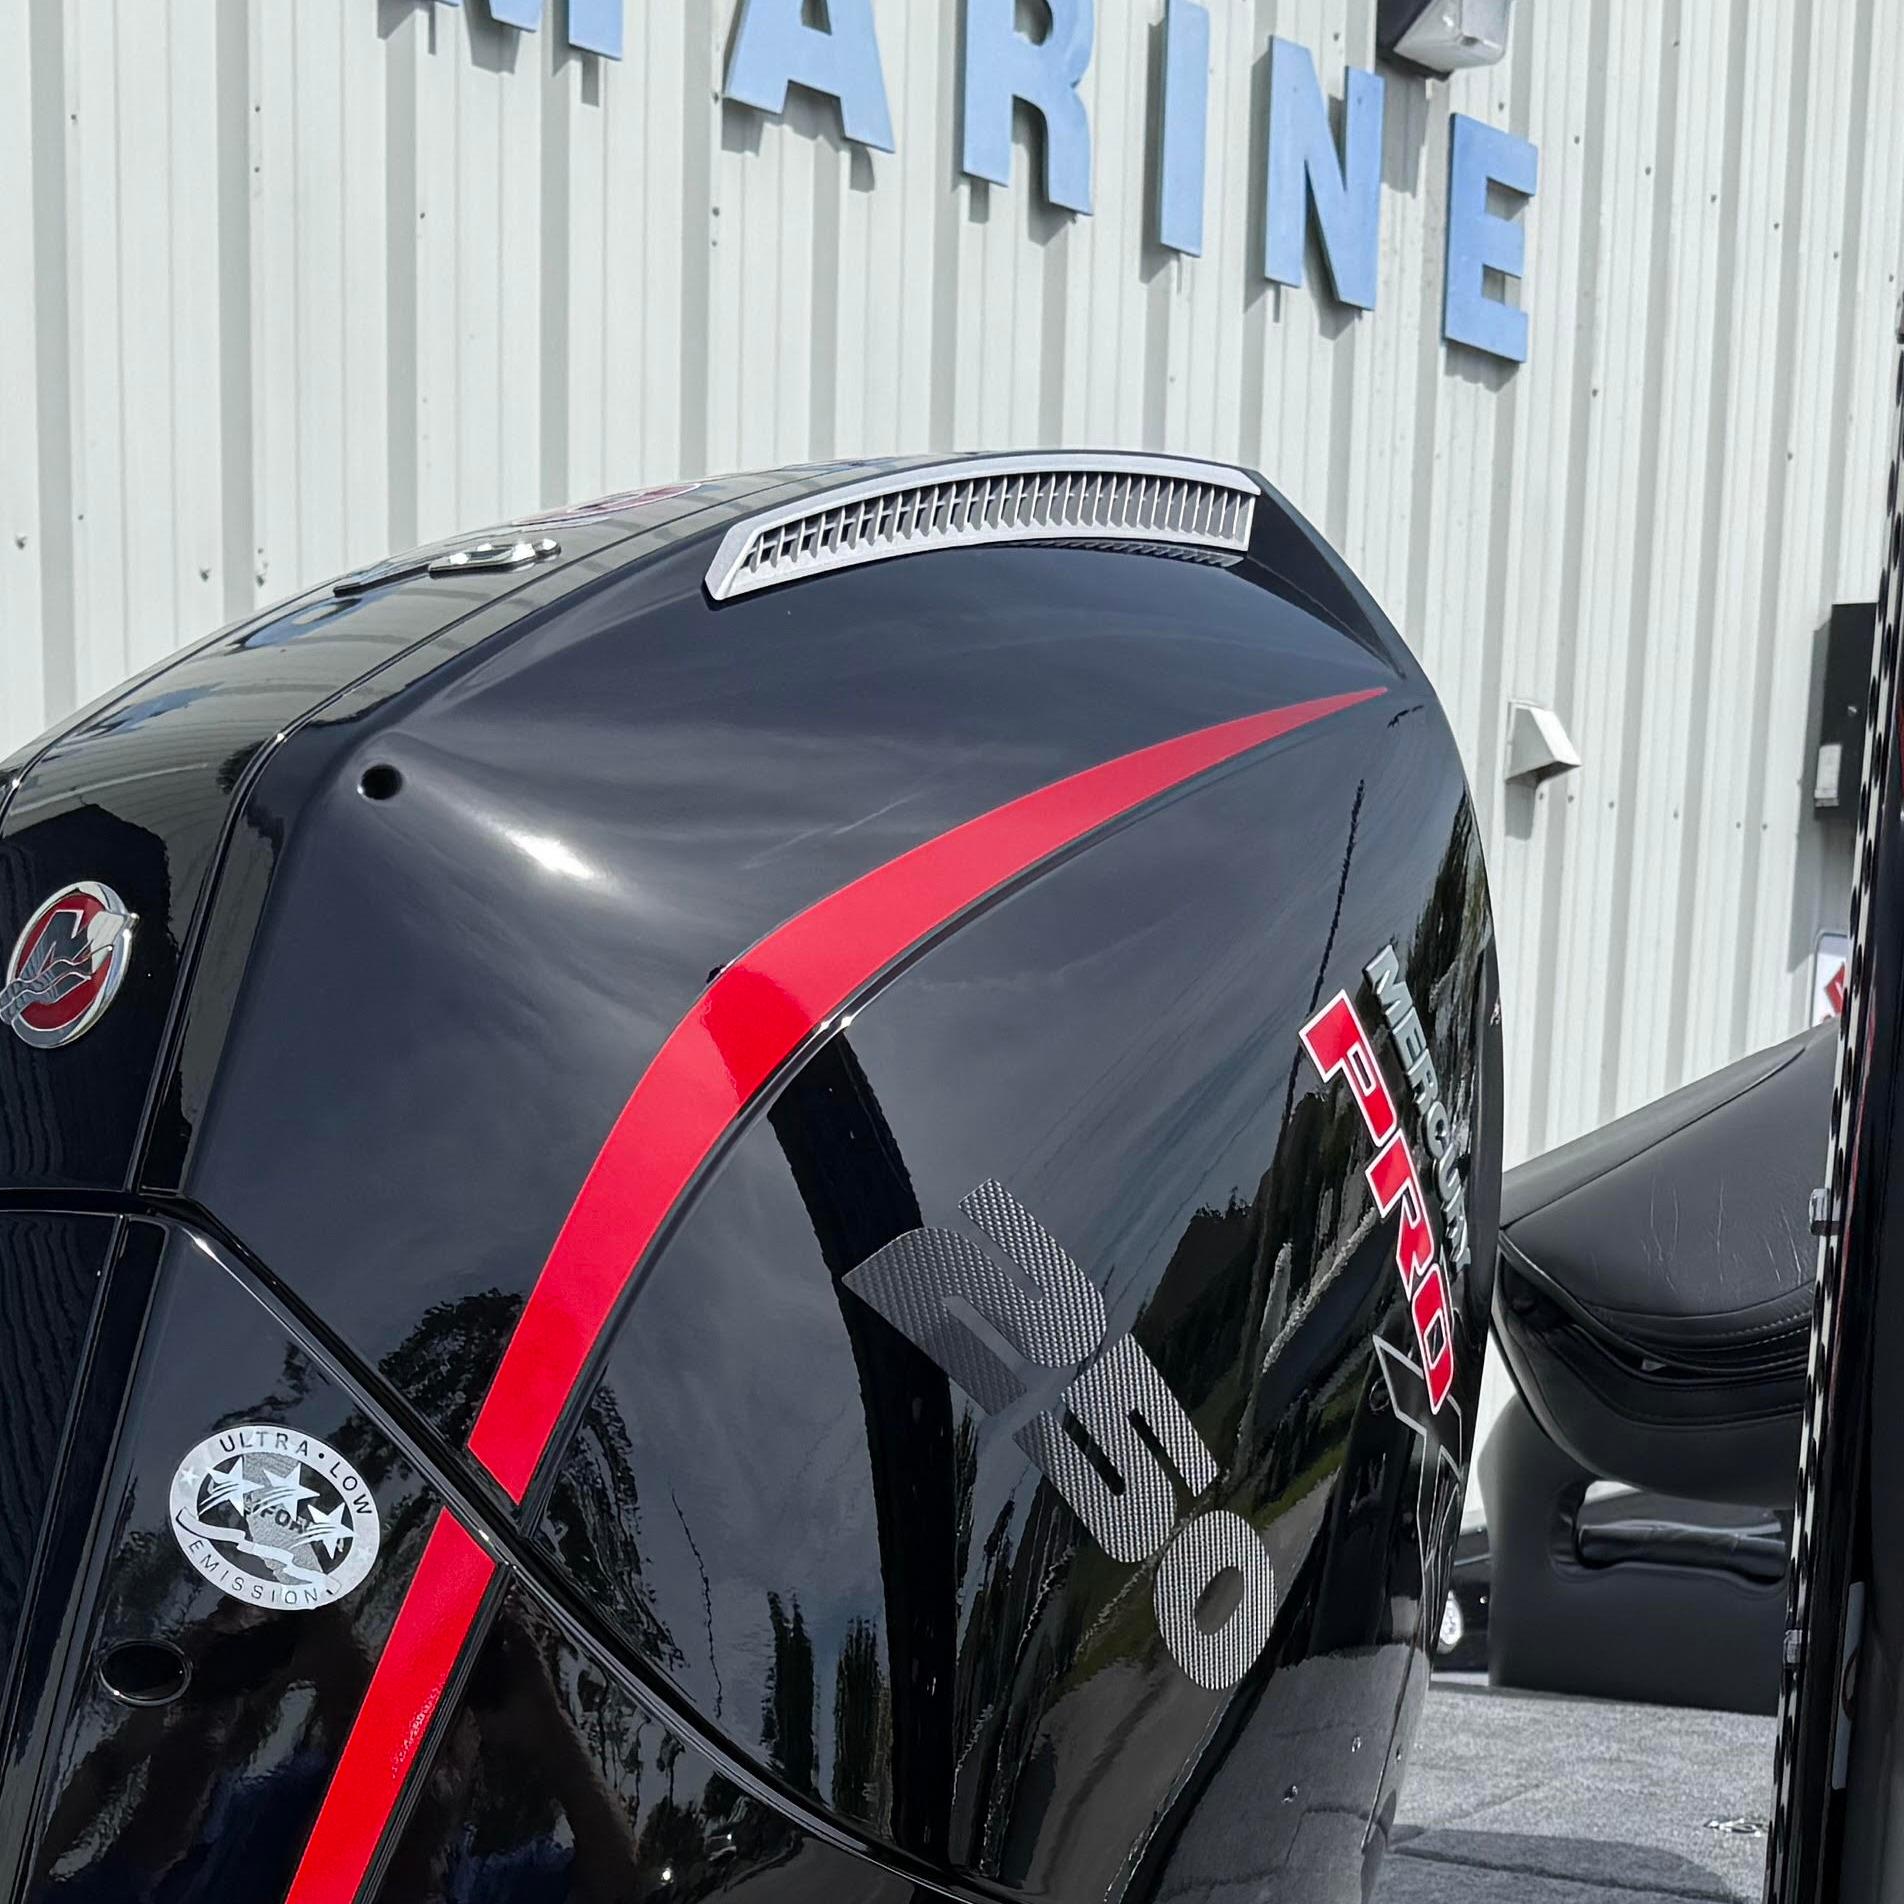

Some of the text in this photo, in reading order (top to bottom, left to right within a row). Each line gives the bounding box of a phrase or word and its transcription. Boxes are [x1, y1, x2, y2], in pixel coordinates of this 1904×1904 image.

[433, 0, 1537, 364] ARINE
[1298, 988, 1455, 1415] PRO
[188, 1538, 318, 1605] EMISSION
[218, 1430, 372, 1515] ULTRA LOW
[841, 1177, 1279, 1691] 250
